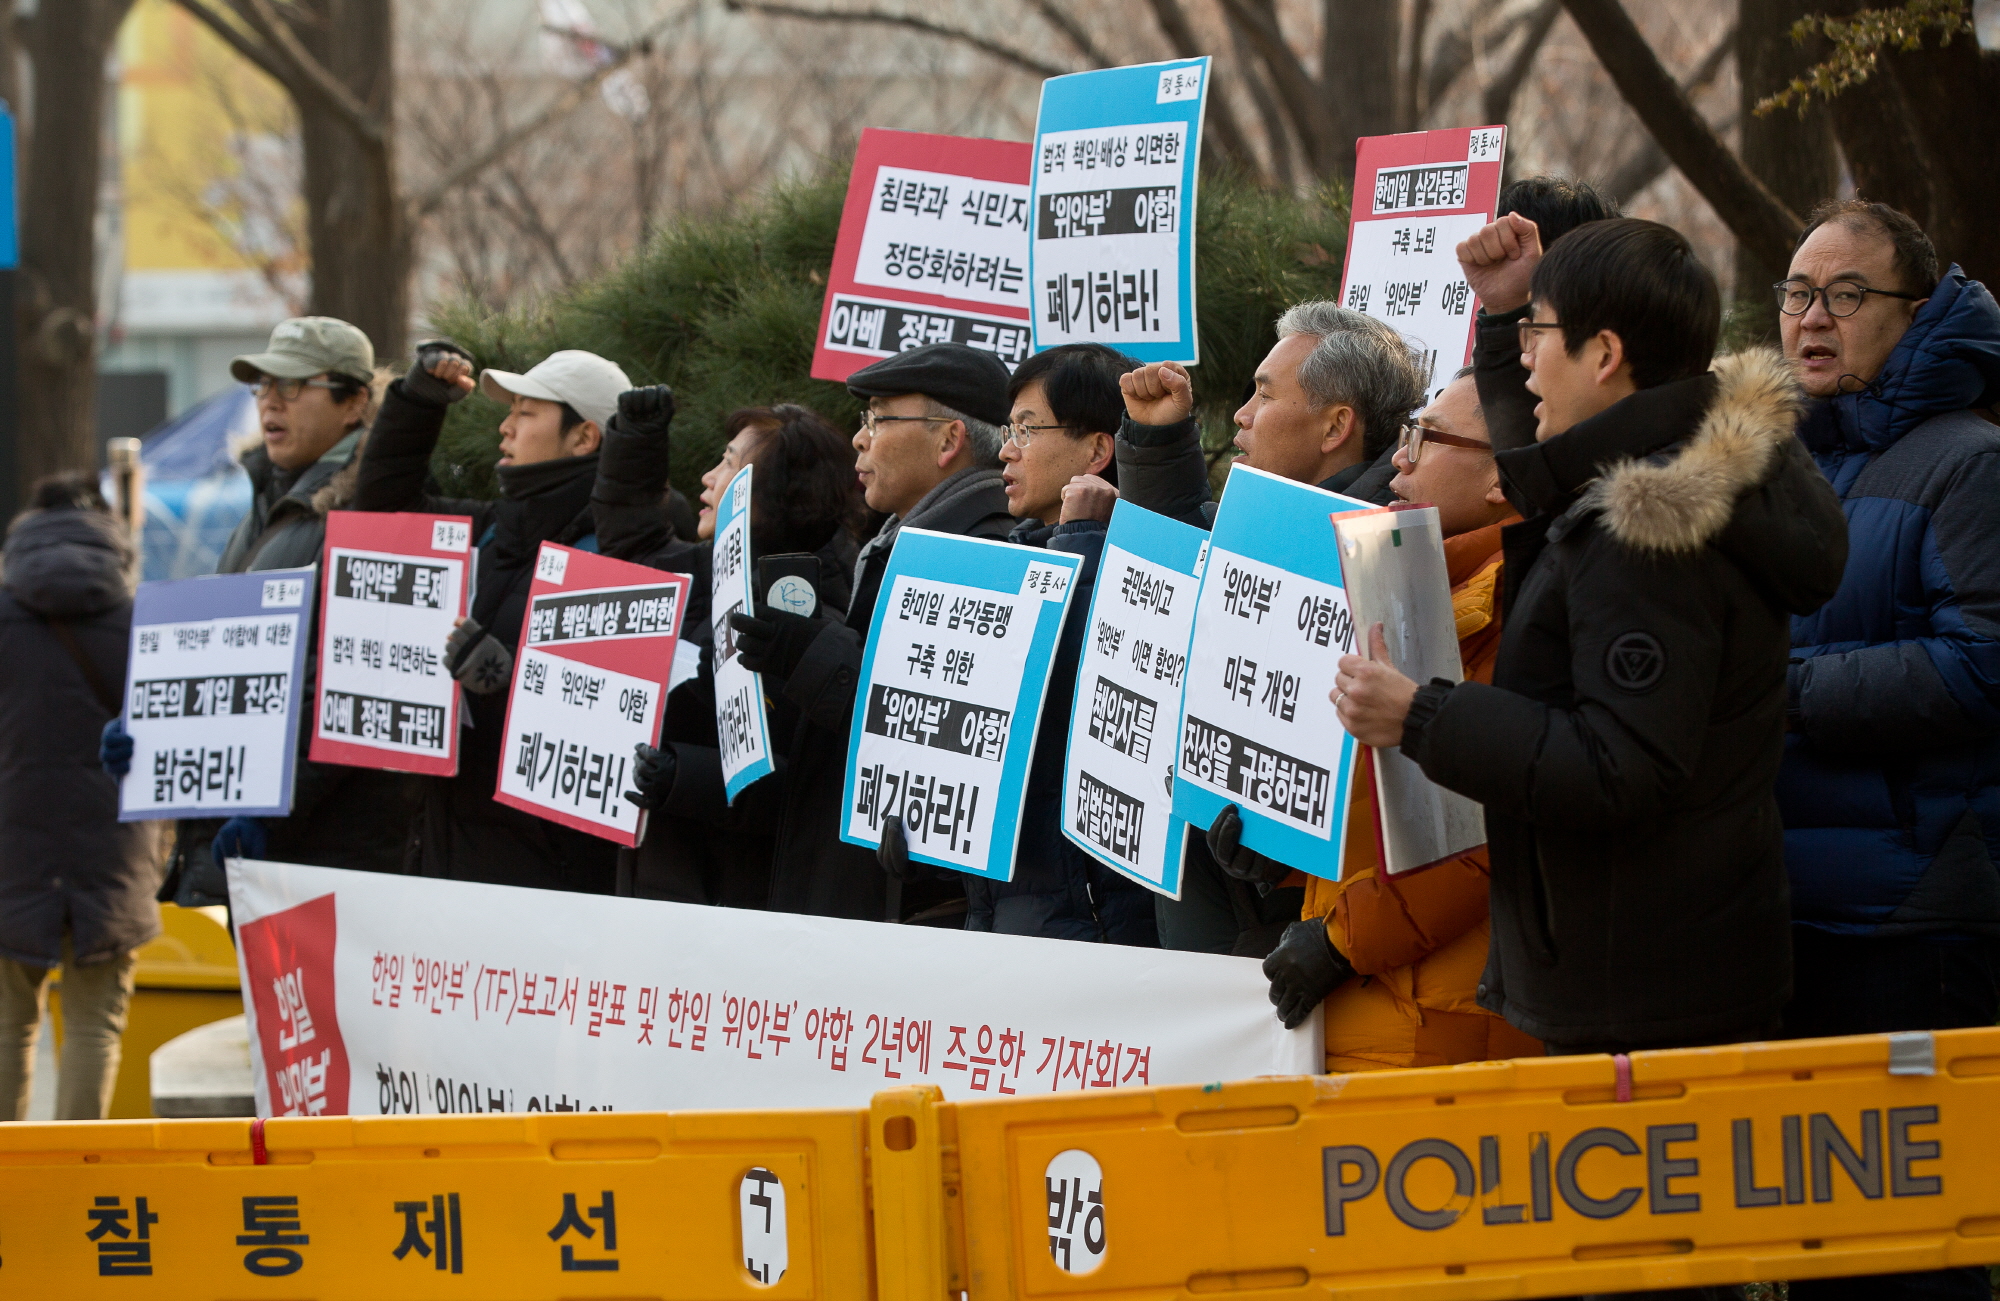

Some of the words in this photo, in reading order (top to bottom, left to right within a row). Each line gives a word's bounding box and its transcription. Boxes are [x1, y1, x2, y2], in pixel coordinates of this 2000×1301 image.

[1162, 74, 1197, 96] 평통사
[1043, 141, 1067, 174] 법적
[1133, 132, 1180, 166] 외면한
[1470, 132, 1500, 157] 평통사
[880, 177, 949, 221] 침략과
[961, 190, 1028, 232] 식민지
[1049, 190, 1113, 238] ‘위안부’
[1134, 189, 1175, 234] 야합
[1375, 171, 1411, 211] 한미일
[1415, 168, 1467, 206] 삼각동맹
[1391, 227, 1411, 256] 구축
[1413, 226, 1436, 254] 노린
[884, 242, 1024, 294] 정당화하려는
[1046, 268, 1160, 334] 폐기하라!
[1384, 279, 1428, 317] ‘위안부’
[1441, 280, 1470, 316] 야합
[831, 304, 887, 351] 아베
[346, 557, 404, 603] ‘위안부’
[412, 567, 448, 610] 문제
[1028, 570, 1067, 594] 평통사
[1121, 565, 1175, 616] 국민속이고
[1223, 561, 1282, 625] ‘위안부’
[1298, 595, 1354, 654] 야합에
[139, 631, 160, 653] 한일
[222, 624, 260, 648] 야합에
[265, 622, 291, 646] 대한
[529, 607, 558, 642] 법적
[625, 596, 675, 634] 외면한
[899, 587, 945, 626] 한미일
[947, 596, 1014, 639] 삼각동맹
[333, 636, 354, 664] 법적
[360, 638, 383, 669] 책임
[388, 642, 438, 677] 외면하는
[906, 642, 936, 680] 구축
[942, 648, 975, 686] 위한
[1131, 639, 1153, 674] 이면
[1154, 646, 1186, 688] 합의?
[131, 680, 187, 718] 미국의
[192, 677, 235, 716] 개입
[244, 675, 288, 714] 진상
[523, 658, 548, 695] 한일
[561, 666, 606, 710] ‘위안부’
[619, 687, 648, 724] 야합
[1223, 655, 1258, 707] 미국
[1261, 669, 1301, 723] 개입
[323, 693, 354, 734] 아베
[360, 699, 393, 741] 정권
[398, 705, 441, 748] 규탄!
[882, 686, 951, 747] ‘위안부’
[960, 710, 1007, 762] 야합
[1091, 681, 1155, 764] 책임자를
[153, 745, 245, 803] 밝혀라!
[515, 732, 626, 818] 폐기하라!
[1184, 722, 1232, 789] 진상을
[1239, 745, 1328, 829] 규명하라!
[856, 763, 980, 855] 폐기하라!
[1077, 778, 1143, 865] 처벌하라!
[273, 966, 316, 1052] 한일
[372, 950, 404, 1008] 한일
[412, 952, 470, 1015] ‘위안부’
[587, 980, 627, 1038] 발표
[637, 986, 659, 1046] 및
[668, 987, 711, 1052] 한일
[722, 990, 798, 1060] ‘위안부’
[804, 1006, 854, 1072] 야합
[862, 1013, 932, 1079] 2년에
[942, 1024, 1026, 1095] 즈음한
[1322, 1123, 1700, 1237] POLICE
[1731, 1105, 1943, 1208] LINE
